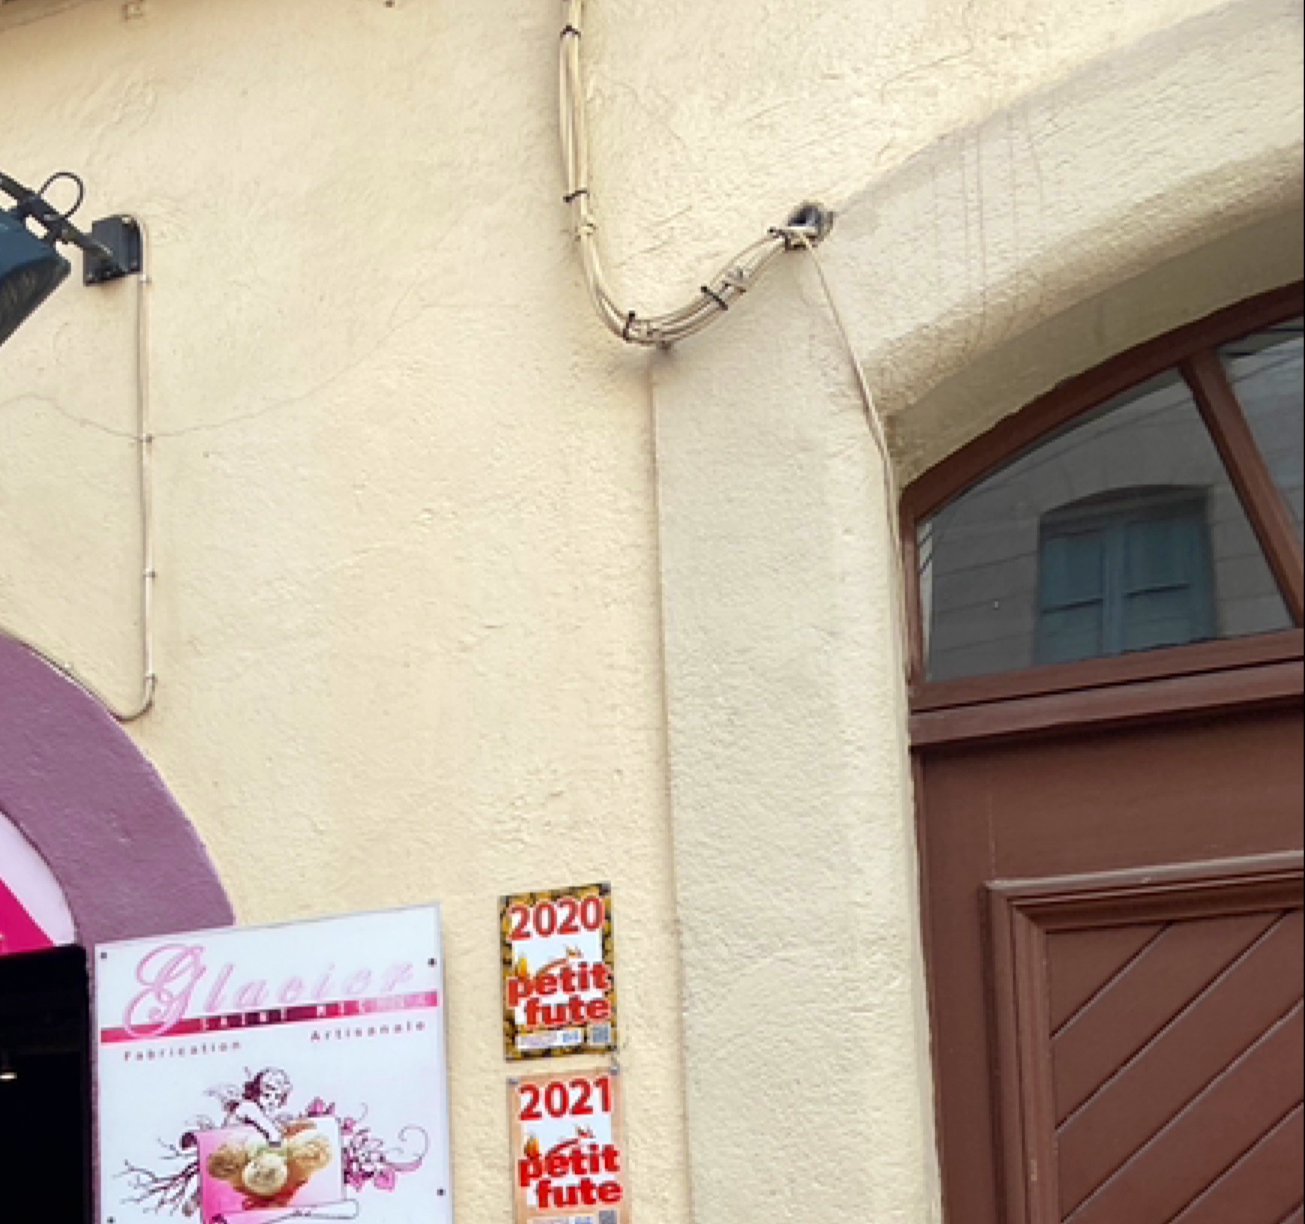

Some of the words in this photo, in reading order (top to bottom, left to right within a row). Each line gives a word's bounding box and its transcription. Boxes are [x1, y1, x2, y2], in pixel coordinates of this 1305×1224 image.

[509, 896, 605, 940] 2020
[124, 944, 414, 1038] Glacier
[506, 961, 612, 1008] petit
[125, 1042, 241, 1061] Fabrication
[310, 1020, 426, 1042] Artisanale
[519, 1077, 612, 1121] 2021
[518, 1144, 621, 1188] petit
